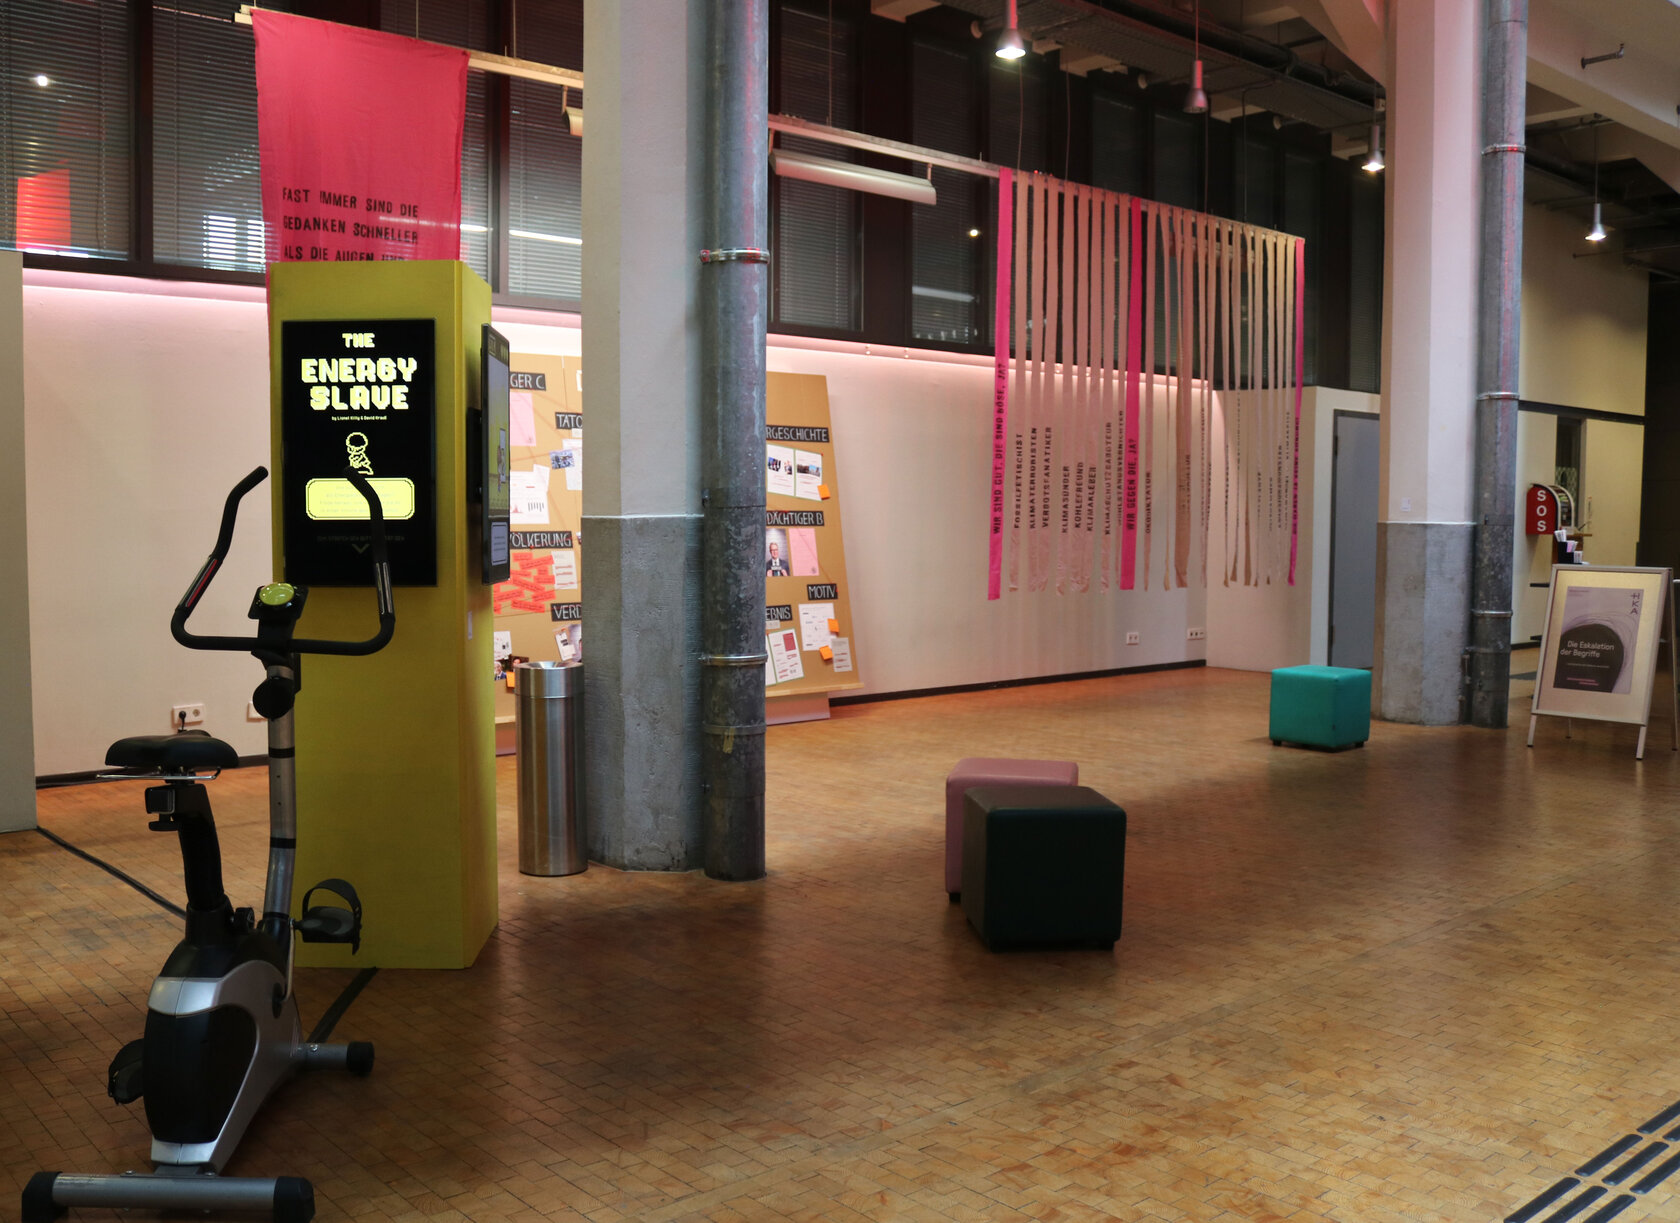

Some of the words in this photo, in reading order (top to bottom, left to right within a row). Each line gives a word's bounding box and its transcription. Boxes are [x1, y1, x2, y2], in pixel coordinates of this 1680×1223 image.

[282, 187, 310, 203] FAST
[319, 190, 357, 209] IMMER
[365, 198, 393, 214] SIND
[400, 203, 419, 218] DIE
[283, 215, 346, 234] GEDANKEN
[353, 223, 419, 244] SCHNELLER
[284, 245, 303, 260] ALS
[310, 246, 329, 260] DIE
[342, 332, 375, 348] THE
[301, 357, 418, 383] ENERGY
[535, 375, 545, 389] C
[310, 385, 409, 410] SLAVE
[816, 512, 824, 525] B
[1536, 490, 1547, 532] SOS
[510, 532, 572, 547] ÖLKERUNG
[808, 585, 836, 599] MOTIV
[1567, 640, 1578, 648] Die
[1579, 641, 1615, 651] Eskalation
[1560, 648, 1571, 656] der
[1573, 649, 1600, 659] Begriffe
